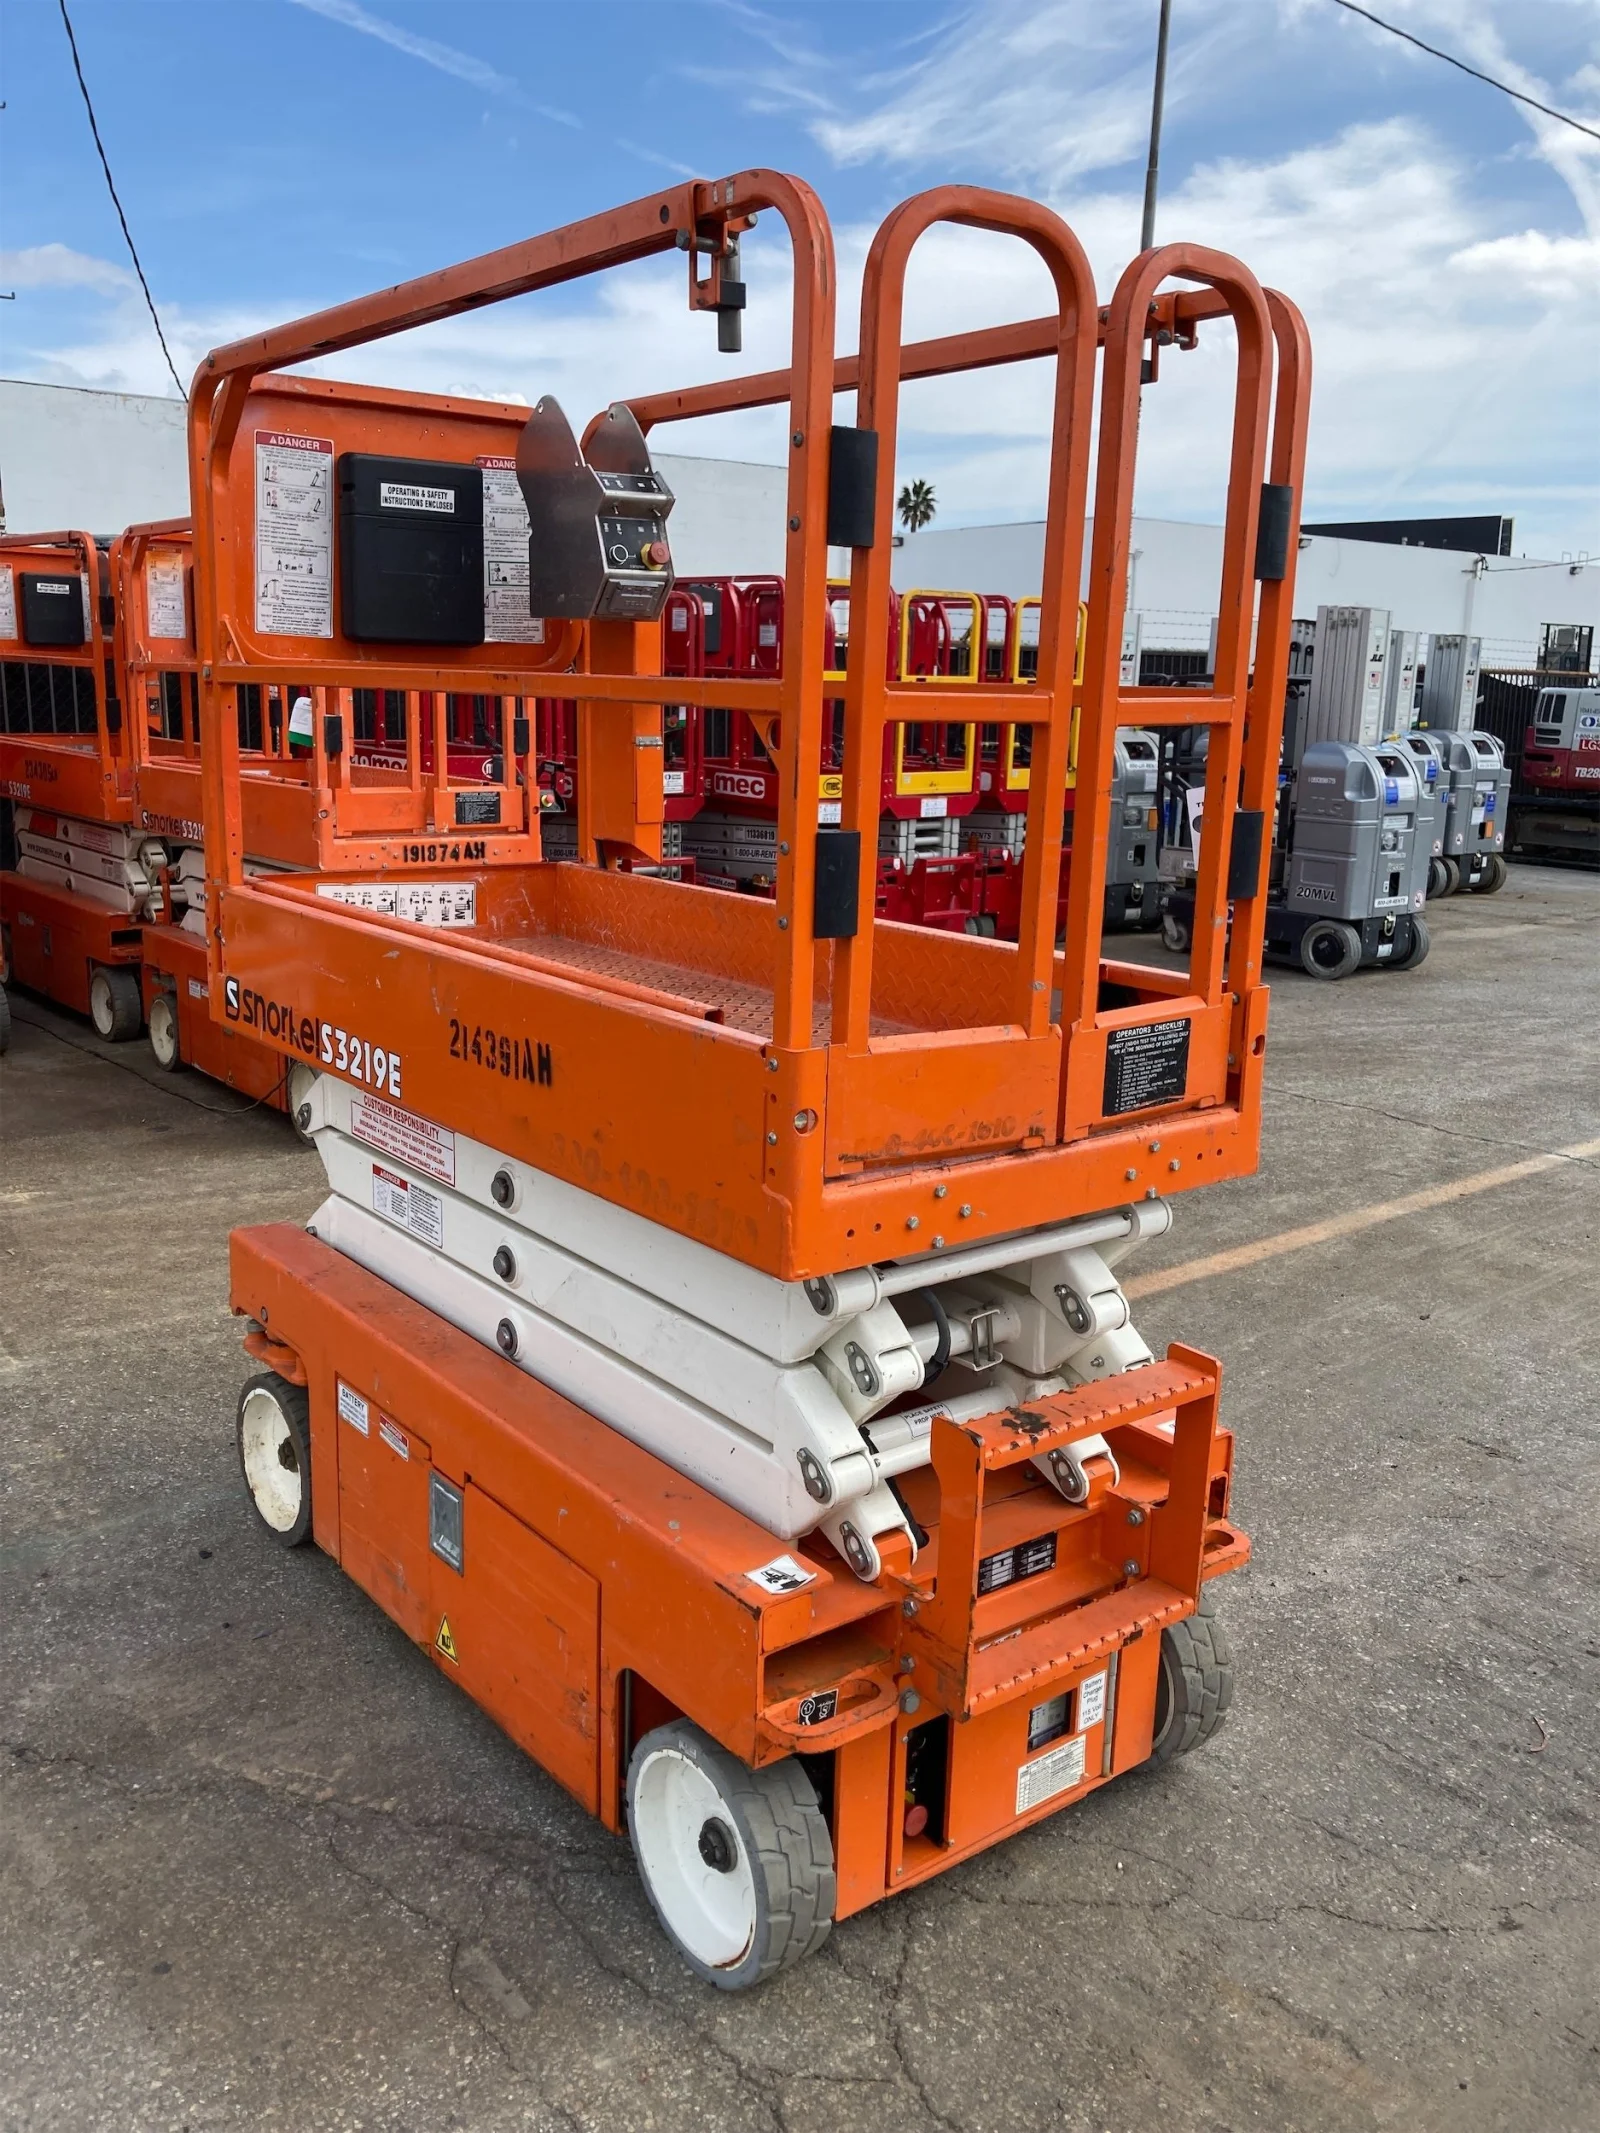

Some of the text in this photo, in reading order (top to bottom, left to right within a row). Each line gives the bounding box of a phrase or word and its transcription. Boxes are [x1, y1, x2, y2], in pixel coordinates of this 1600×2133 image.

[277, 436, 320, 451] DANGER
[387, 486, 448, 500] OPERATING & SAFETY
[381, 496, 454, 511] INSTRUCTIONS ENCLOSED
[1120, 654, 1134, 662] JLG
[1370, 654, 1384, 663] JLG
[1575, 766, 1600, 778] TB28
[8, 780, 31, 799] S3219E
[715, 773, 764, 797] mec
[149, 813, 182, 837] snorkel
[1297, 886, 1338, 902] 20MVL
[1115, 1019, 1186, 1039] OPERATORS CHECKLIST
[242, 989, 321, 1060] snorkel
[320, 1022, 402, 1099] S3219E
[363, 1094, 440, 1141] CUSTOMER RESPONSIBILITY
[342, 1387, 365, 1411] BATTERY
[914, 1415, 930, 1425] PROP
[1082, 1685, 1103, 1699] Charger
[1084, 1678, 1102, 1691] Battery
[1082, 1703, 1102, 1718] 115 Volt
[1083, 1711, 1099, 1725] ONLY
